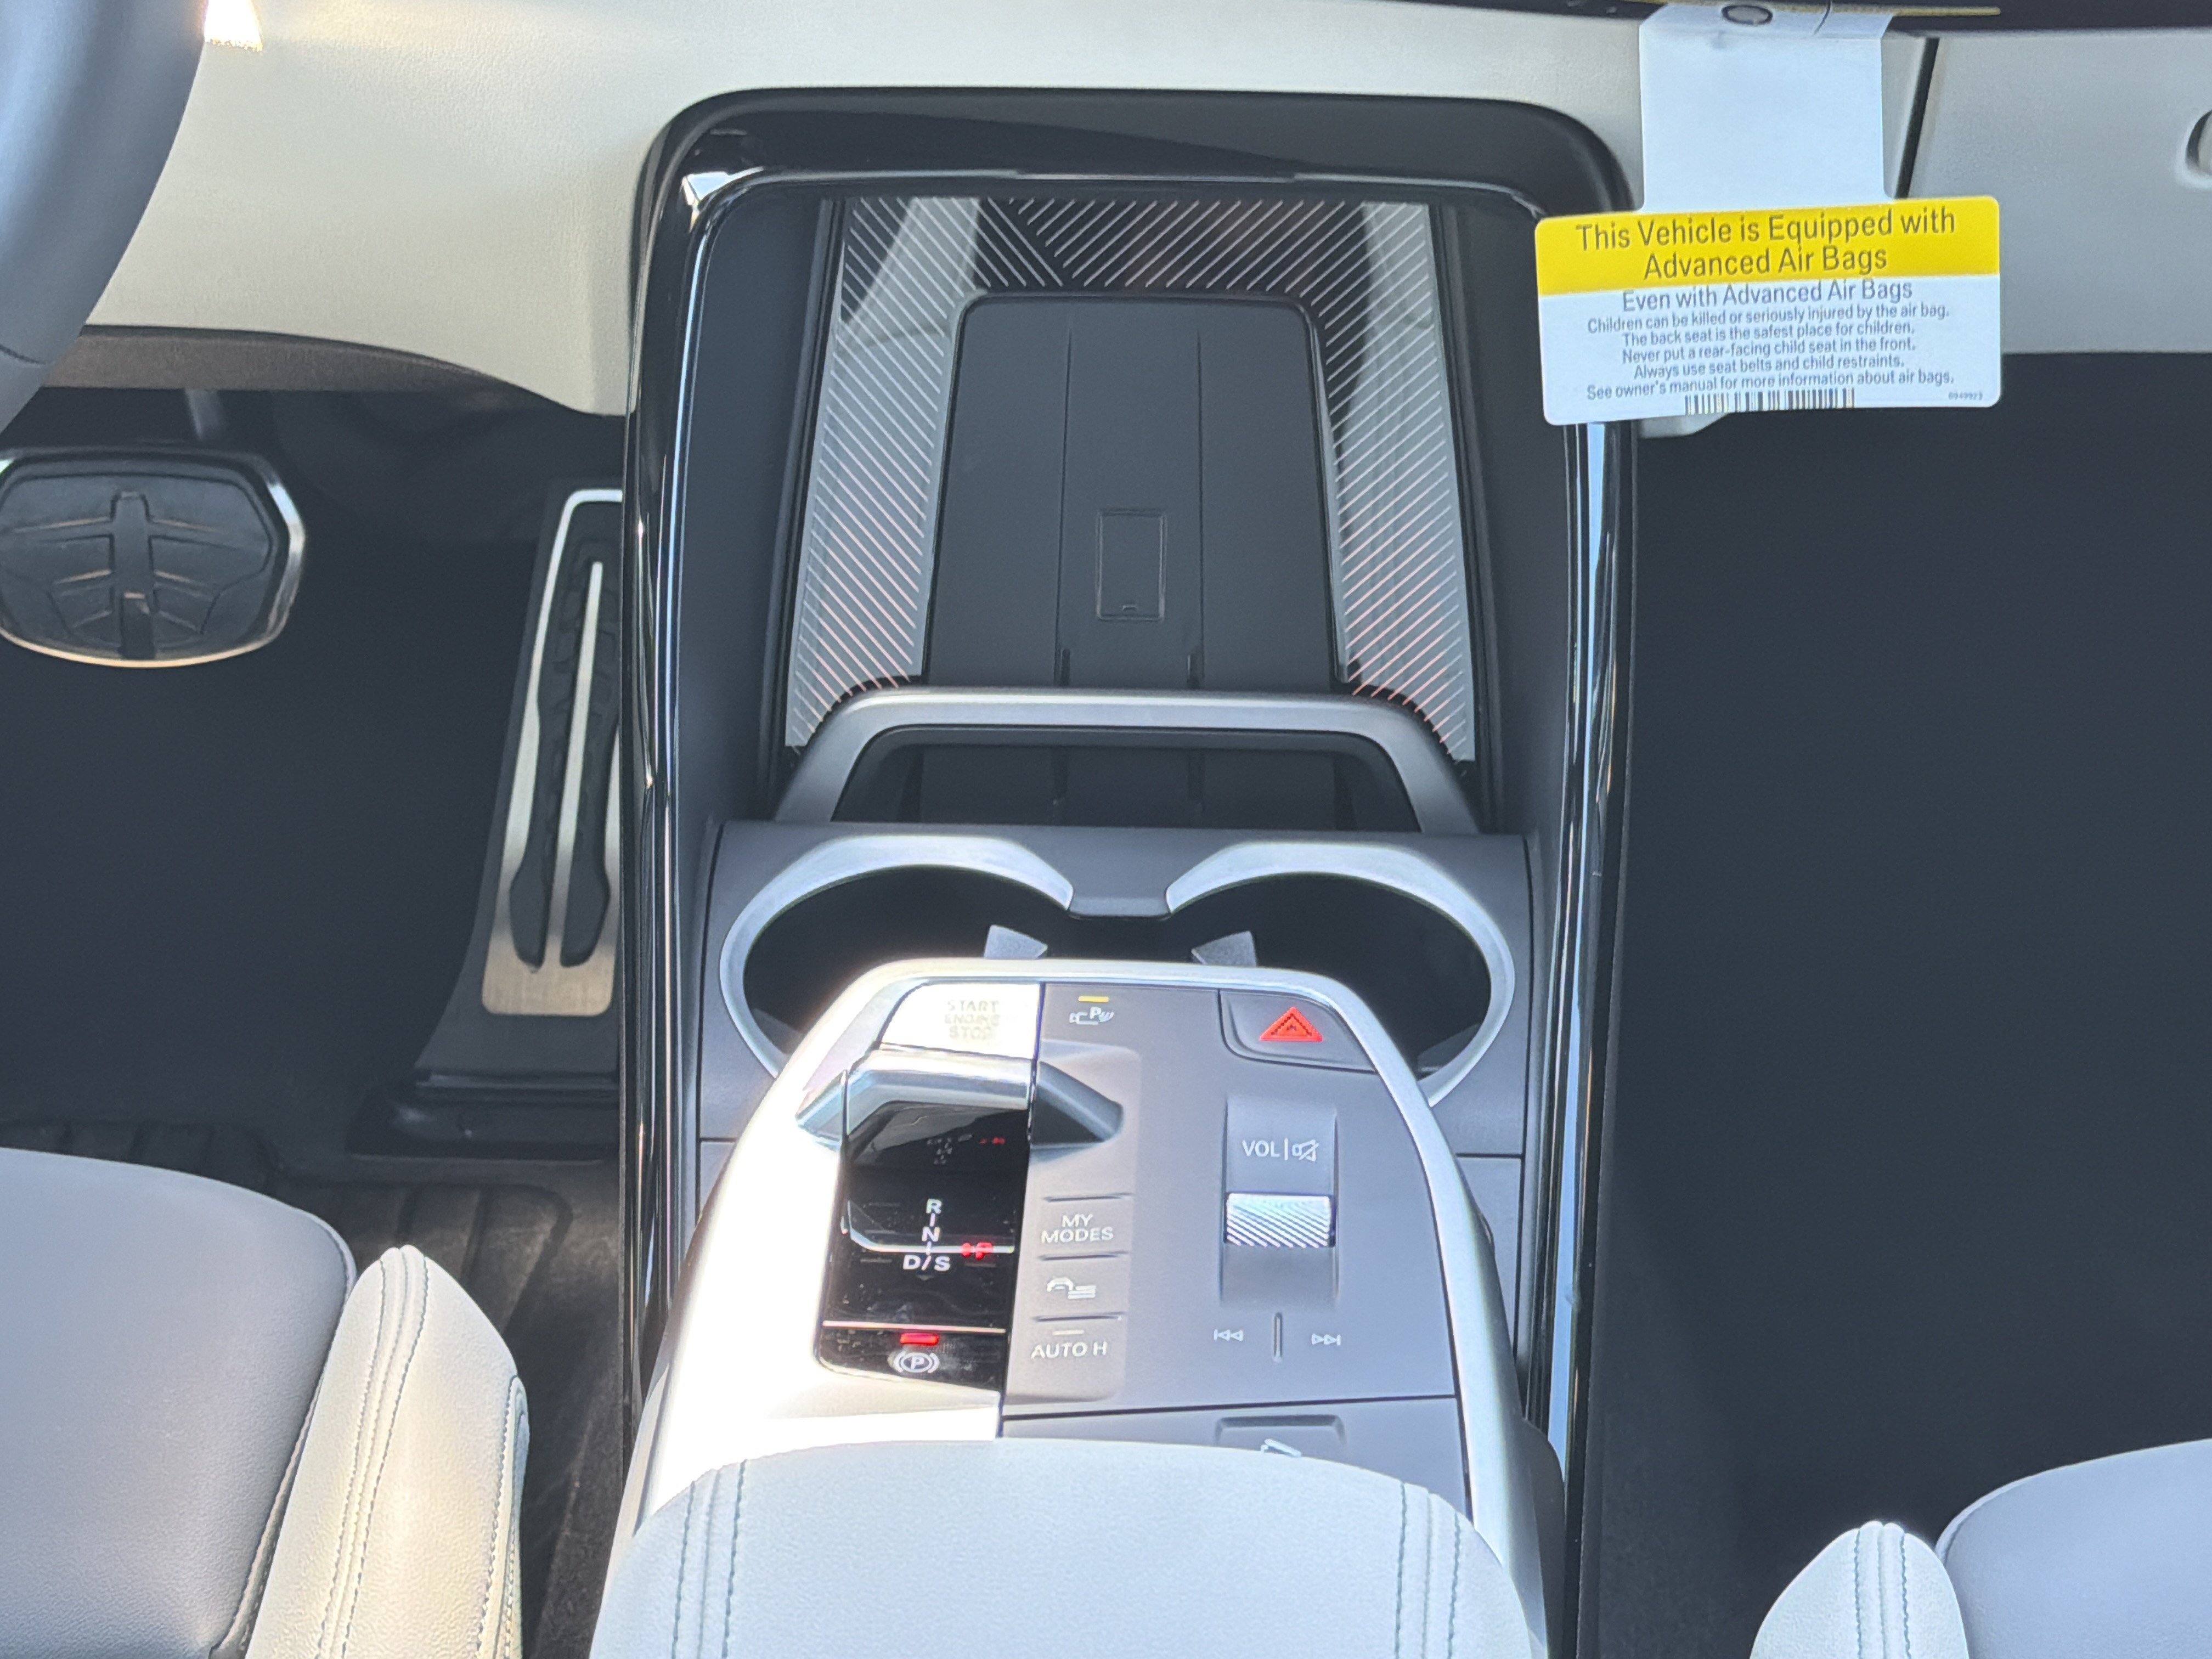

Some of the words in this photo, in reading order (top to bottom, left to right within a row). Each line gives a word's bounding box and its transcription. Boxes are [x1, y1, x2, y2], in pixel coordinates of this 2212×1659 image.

[1576, 221, 1630, 251] This
[1637, 217, 1731, 246] Vehicle
[1740, 215, 1759, 242] is
[1769, 208, 1892, 244] Equipped
[1901, 206, 1955, 234] with
[1644, 246, 1770, 280] Advanced
[1779, 244, 1814, 273] Air
[1822, 245, 1887, 275] Bags
[1623, 289, 1671, 312] Even
[1676, 285, 1717, 307] with
[1723, 280, 1822, 306] Advanced
[1827, 279, 1856, 301] Air
[1862, 278, 1912, 303] Bags
[1588, 315, 1642, 334] Children
[1645, 317, 1669, 329] can
[1672, 312, 1688, 328] be
[1691, 309, 1726, 326] killed
[1729, 311, 1742, 324] or
[1746, 306, 1804, 323] seriously
[1808, 304, 1853, 323] injured
[1857, 303, 1872, 322] by
[1876, 303, 1897, 318] the
[1900, 303, 1917, 317] air
[1920, 302, 1949, 320] bag.
[1622, 331, 1647, 347] The
[1651, 329, 1681, 345] back
[1684, 328, 1712, 342] seat
[1716, 327, 1726, 341] is
[1730, 325, 1750, 340] the
[1754, 324, 1792, 339] safest
[1797, 322, 1832, 340] place
[1836, 321, 1853, 336] for
[1857, 320, 1915, 335] children.
[1623, 347, 1660, 364] Never
[1664, 347, 1684, 363] put
[1688, 348, 1695, 360] a
[1699, 340, 1770, 358] rear-facing
[1774, 339, 1805, 355] child
[1809, 338, 1837, 353] seat
[1840, 338, 1852, 352] in
[1855, 337, 1876, 351] the
[1880, 336, 1916, 351] front.
[1634, 364, 1679, 381] Always
[1683, 362, 1706, 376] use
[1709, 359, 1736, 375] seat
[1740, 357, 1771, 373] belts
[1775, 356, 1799, 371] and
[1803, 354, 1834, 370] child
[1838, 352, 1904, 369] restraints.
[1587, 384, 1612, 400] See
[1615, 380, 1666, 398] owner's
[1669, 376, 1717, 394] manual
[1720, 375, 1737, 390] for
[1741, 377, 1775, 389] more
[1778, 371, 1853, 387] information
[1857, 369, 1894, 385] about
[1898, 369, 1914, 384] air
[1918, 367, 1954, 387] bags.
[947, 1000, 999, 1013] START
[1242, 1140, 1280, 1157] VOL
[926, 1198, 942, 1214] R
[1062, 1213, 1093, 1228] MY
[921, 1226, 940, 1242] N
[1041, 1226, 1114, 1244] MODES
[903, 1254, 951, 1271] D/S
[1031, 1342, 1088, 1359] AUTO
[1093, 1341, 1107, 1356] H
